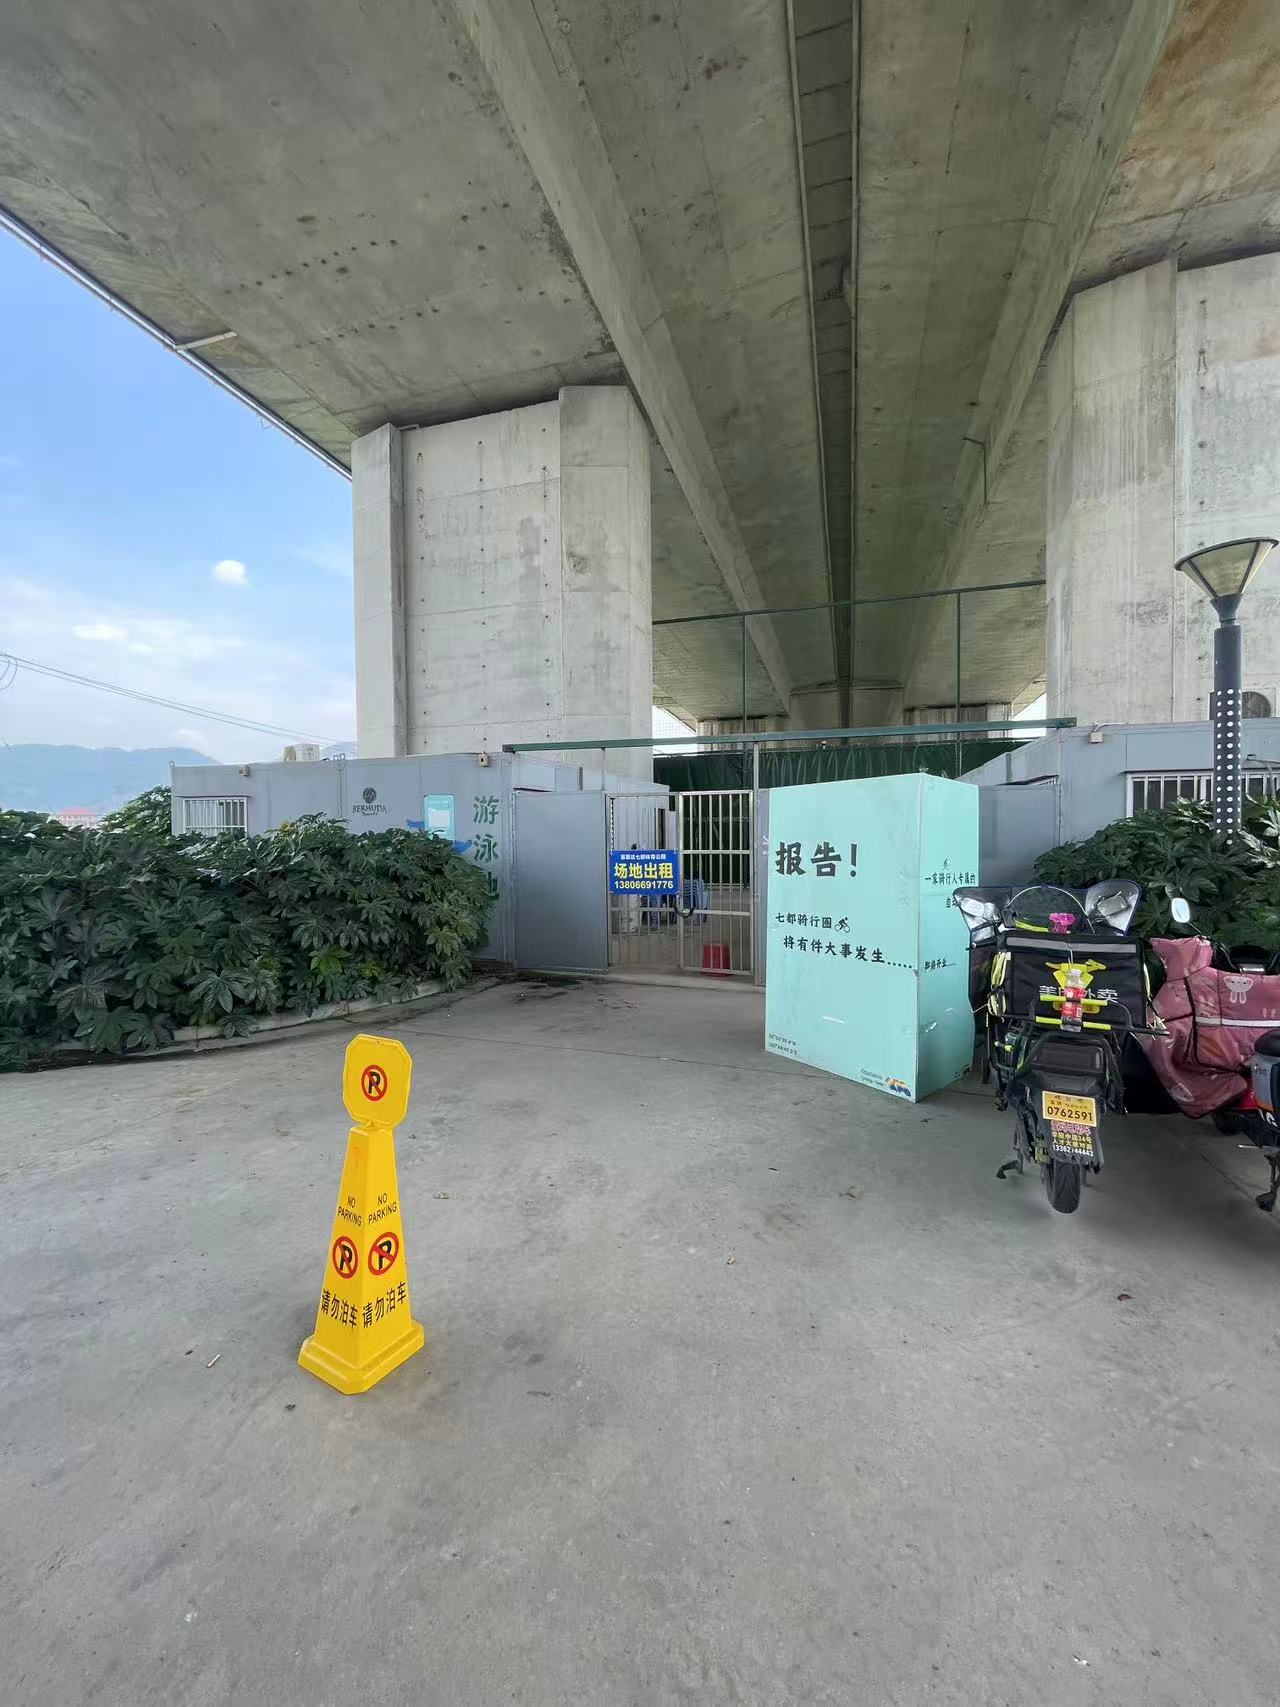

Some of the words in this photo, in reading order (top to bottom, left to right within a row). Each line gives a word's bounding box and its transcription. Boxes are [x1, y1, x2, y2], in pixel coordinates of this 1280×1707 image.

[352, 804, 387, 814] BERMUDA
[614, 862, 674, 879] 场地出租
[614, 880, 674, 889] 13806691776
[1047, 1106, 1093, 1121] 0762591
[347, 1195, 356, 1208] NO
[377, 1192, 388, 1206] NO
[337, 1206, 362, 1227] PARKING
[368, 1202, 397, 1224] PARKING
[321, 1289, 358, 1329] 请勿泊车
[362, 1281, 407, 1328] 请勿泊车
